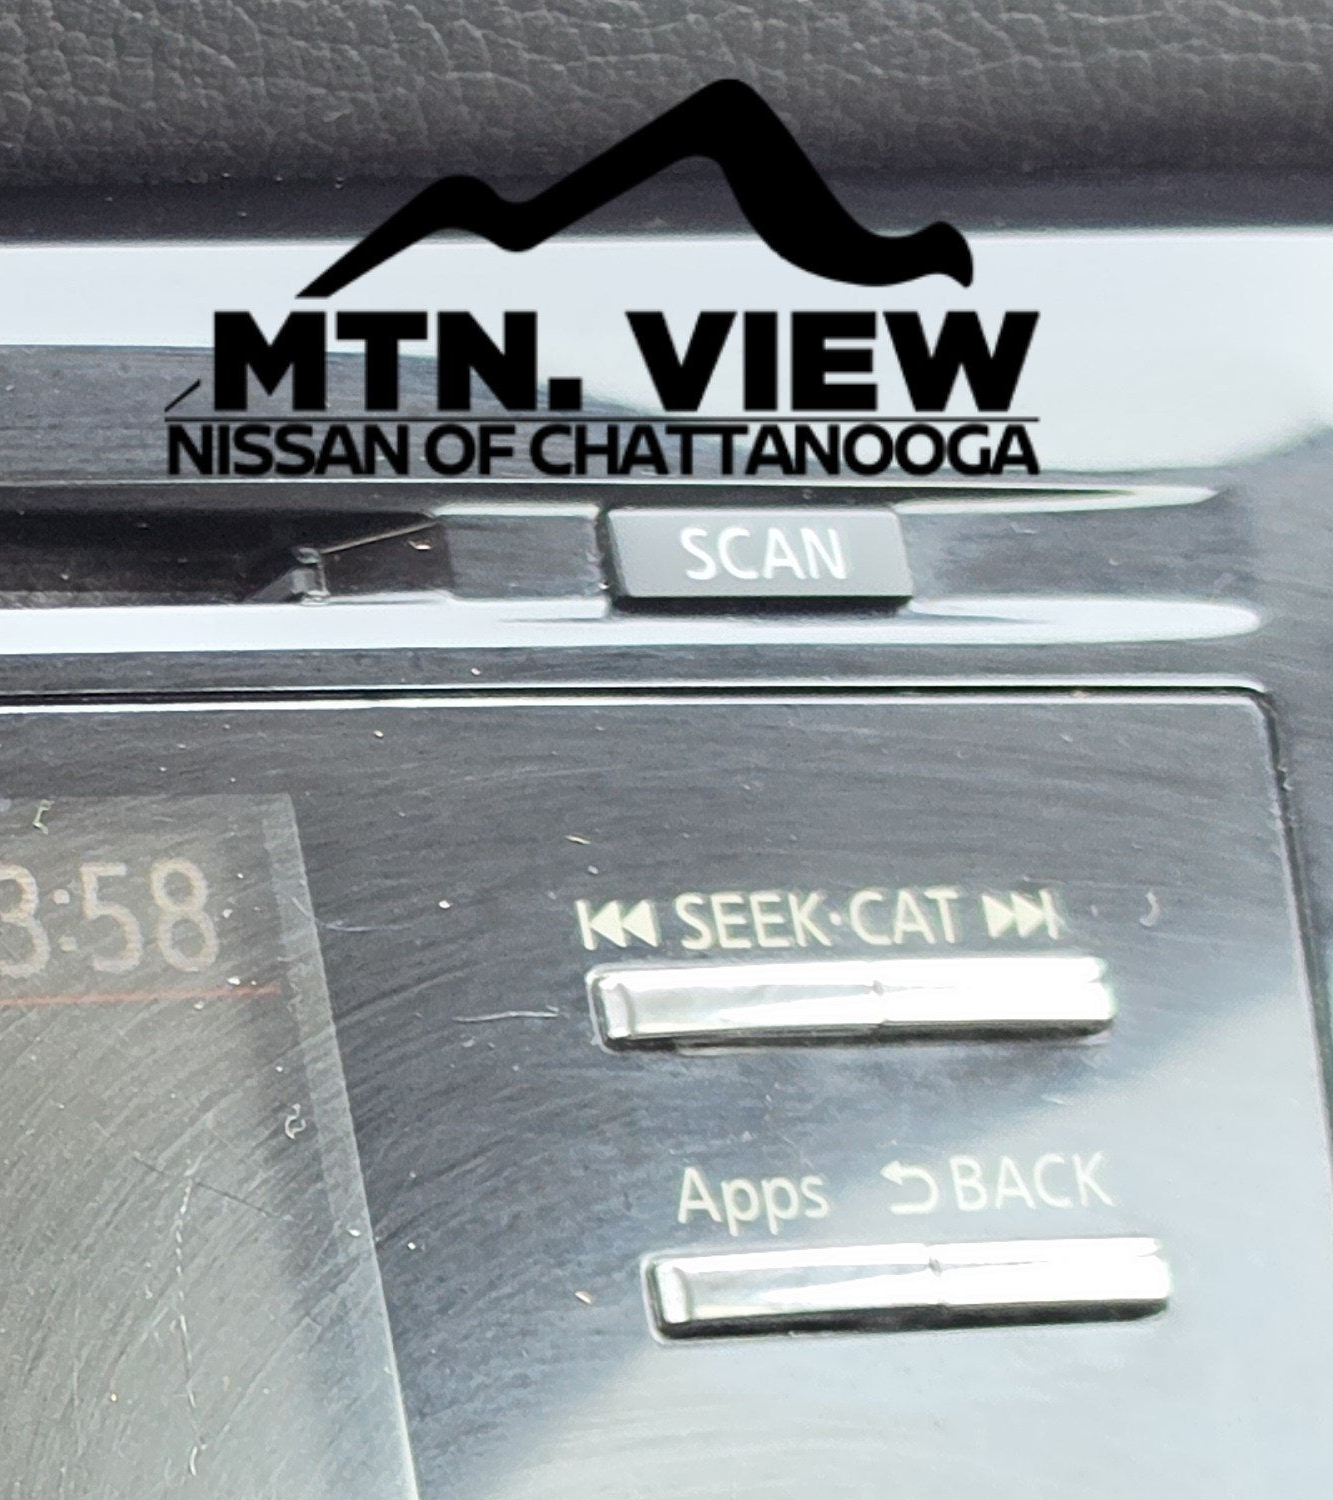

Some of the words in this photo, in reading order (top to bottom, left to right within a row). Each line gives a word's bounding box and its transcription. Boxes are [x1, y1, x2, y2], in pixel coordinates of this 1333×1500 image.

[680, 524, 848, 581] SCAN
[677, 1166, 830, 1235] Apps
[948, 1152, 1115, 1211] BACK
